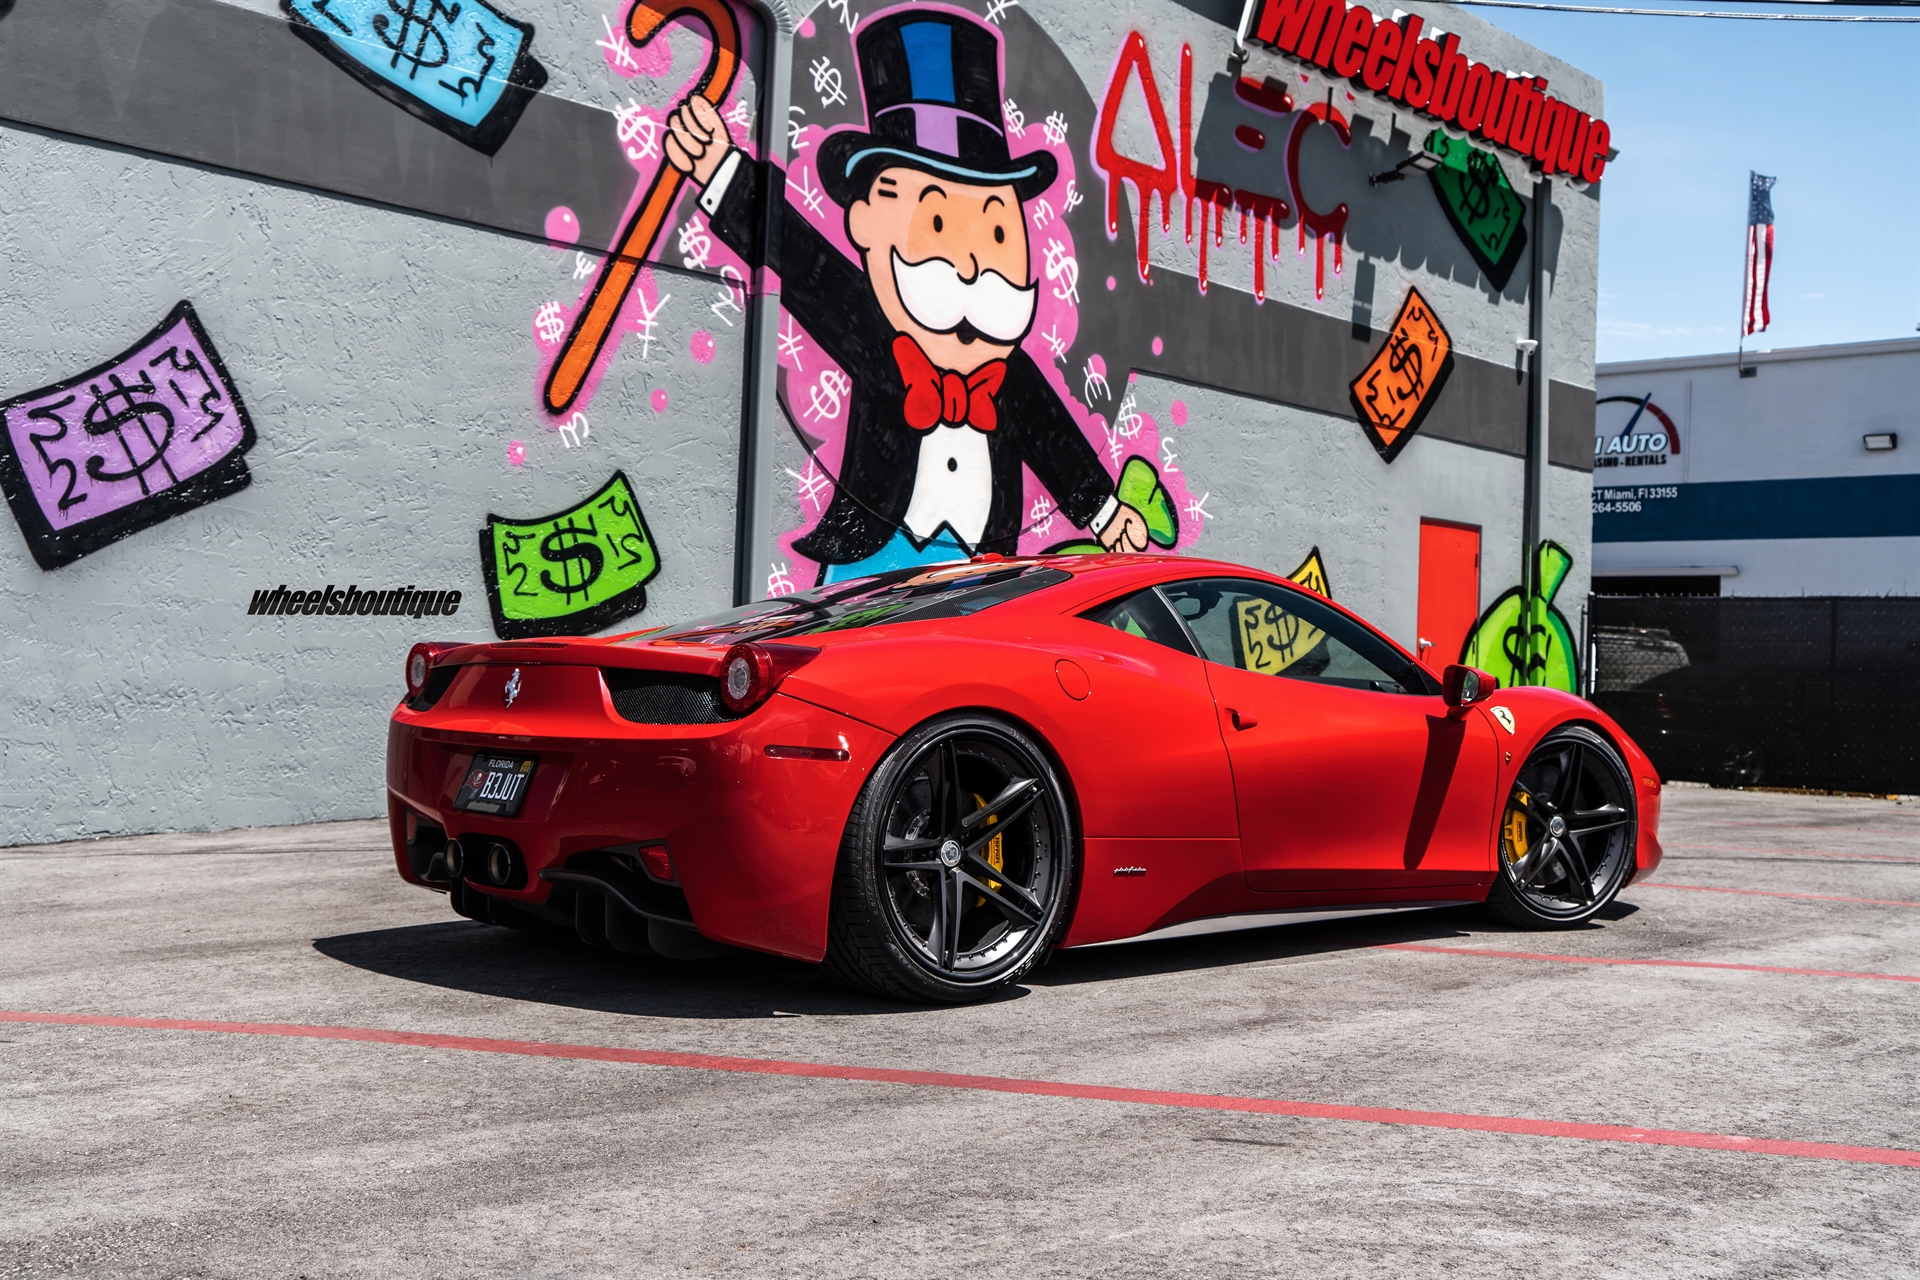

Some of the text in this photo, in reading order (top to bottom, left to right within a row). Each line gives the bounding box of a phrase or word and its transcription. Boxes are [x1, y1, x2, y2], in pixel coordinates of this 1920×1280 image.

[1257, 0, 1611, 184] wheelsboutique
[1605, 432, 1668, 455] AUTO
[1625, 454, 1667, 467] RENTALS
[1604, 488, 1637, 501] Miami,
[1649, 487, 1678, 499] 33155
[1592, 501, 1642, 513] 264-5506
[488, 759, 514, 769] FLORIDA
[480, 771, 525, 801] B3JUT
